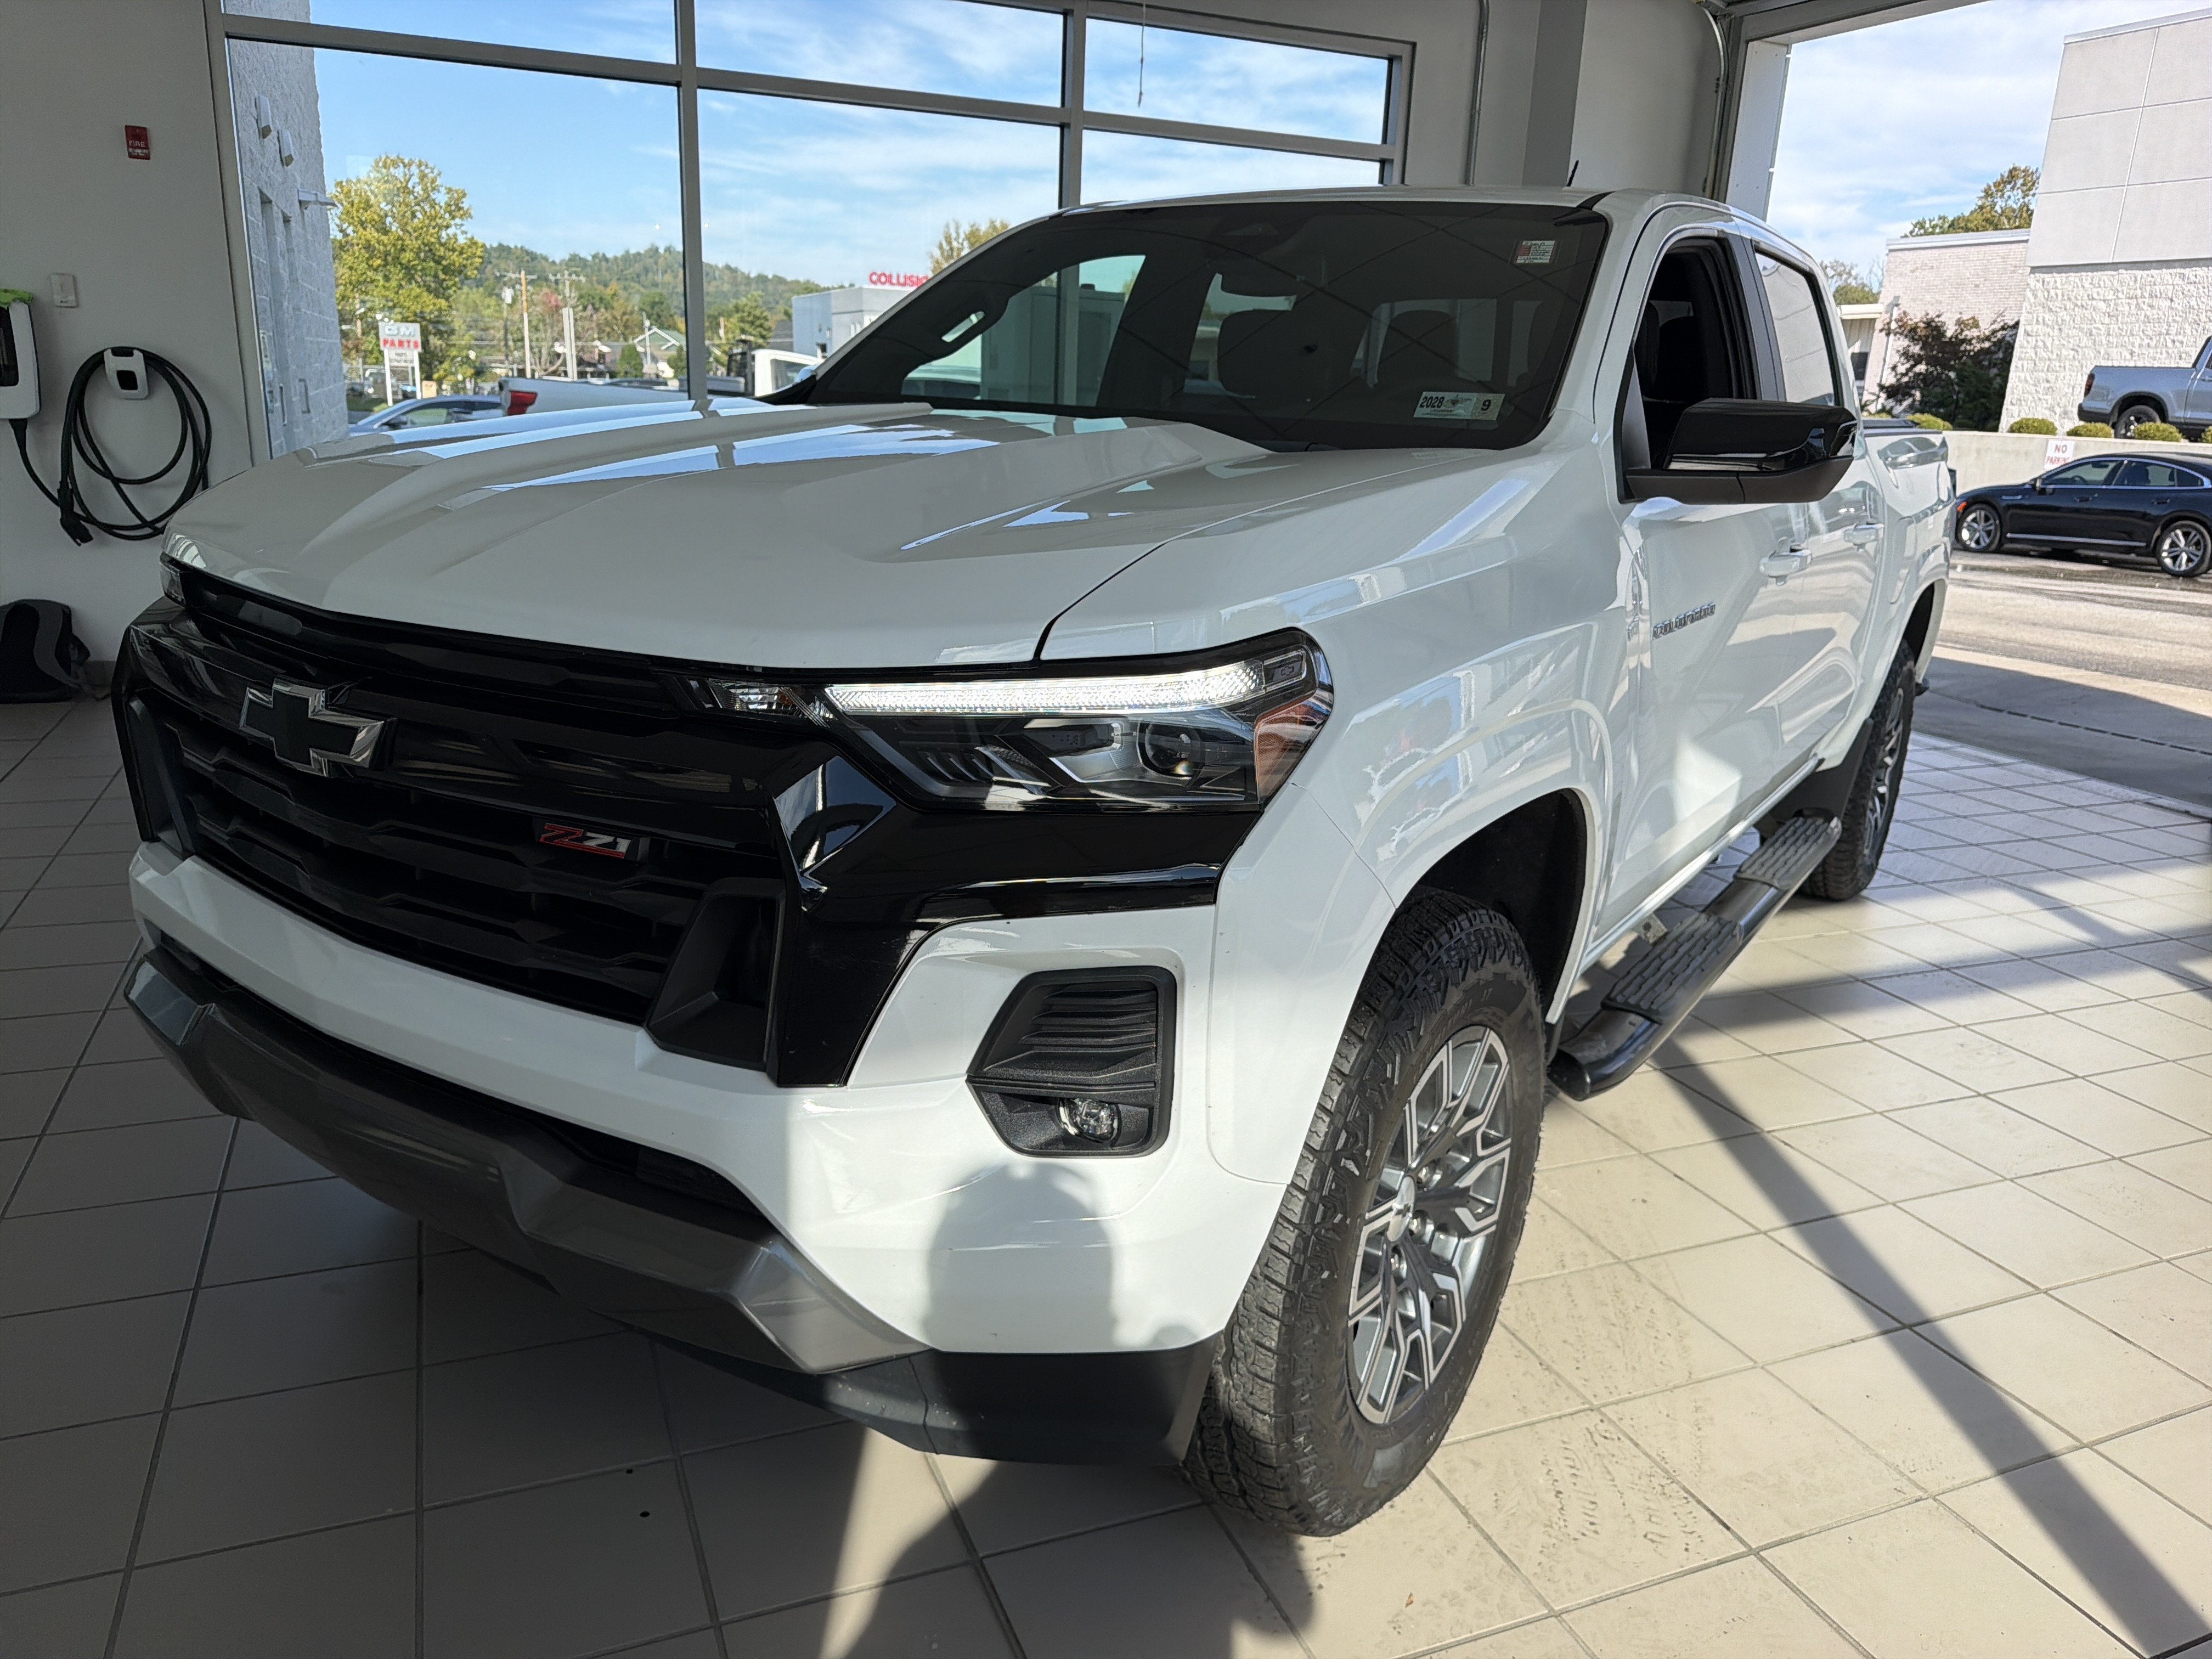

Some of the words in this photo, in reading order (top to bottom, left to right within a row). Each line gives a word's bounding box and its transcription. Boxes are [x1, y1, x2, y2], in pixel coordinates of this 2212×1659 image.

[385, 325, 415, 336] GM
[382, 338, 419, 349] PARTS
[1419, 396, 1445, 408] 2028
[1481, 399, 1492, 411] 9
[2054, 443, 2068, 454] NO
[1652, 602, 1716, 640] COLORADO
[539, 822, 631, 859] Z71
